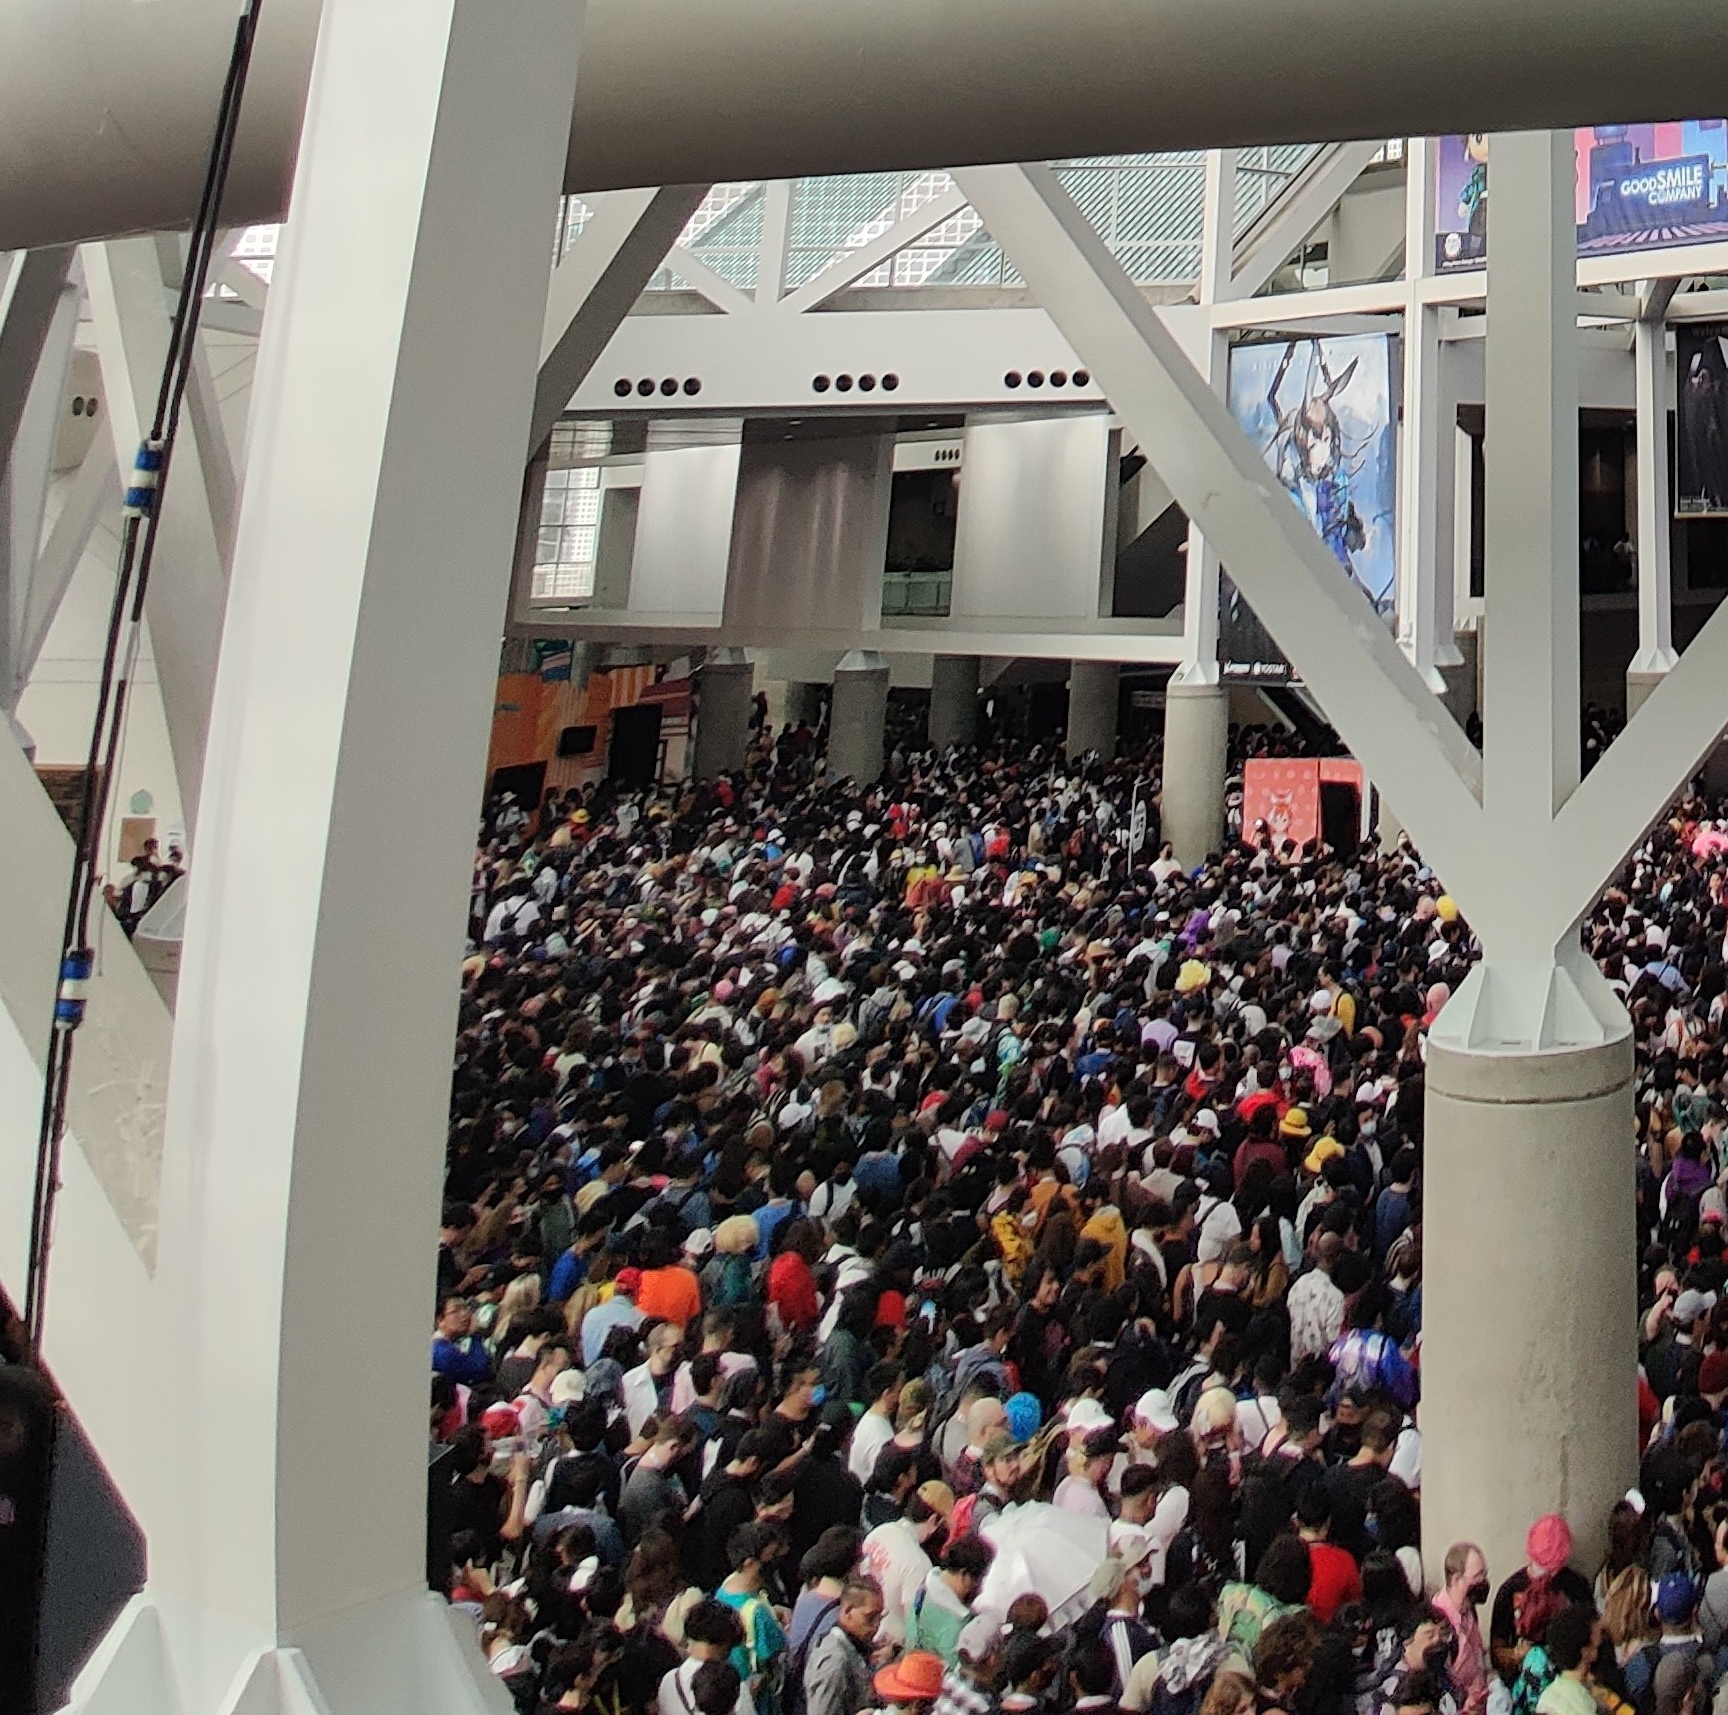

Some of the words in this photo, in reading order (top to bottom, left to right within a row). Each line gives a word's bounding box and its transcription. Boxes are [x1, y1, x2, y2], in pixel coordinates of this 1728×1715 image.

[1620, 177, 1658, 196] GOOD
[1657, 165, 1703, 189] SMILE
[1648, 184, 1702, 205] COMPANY
